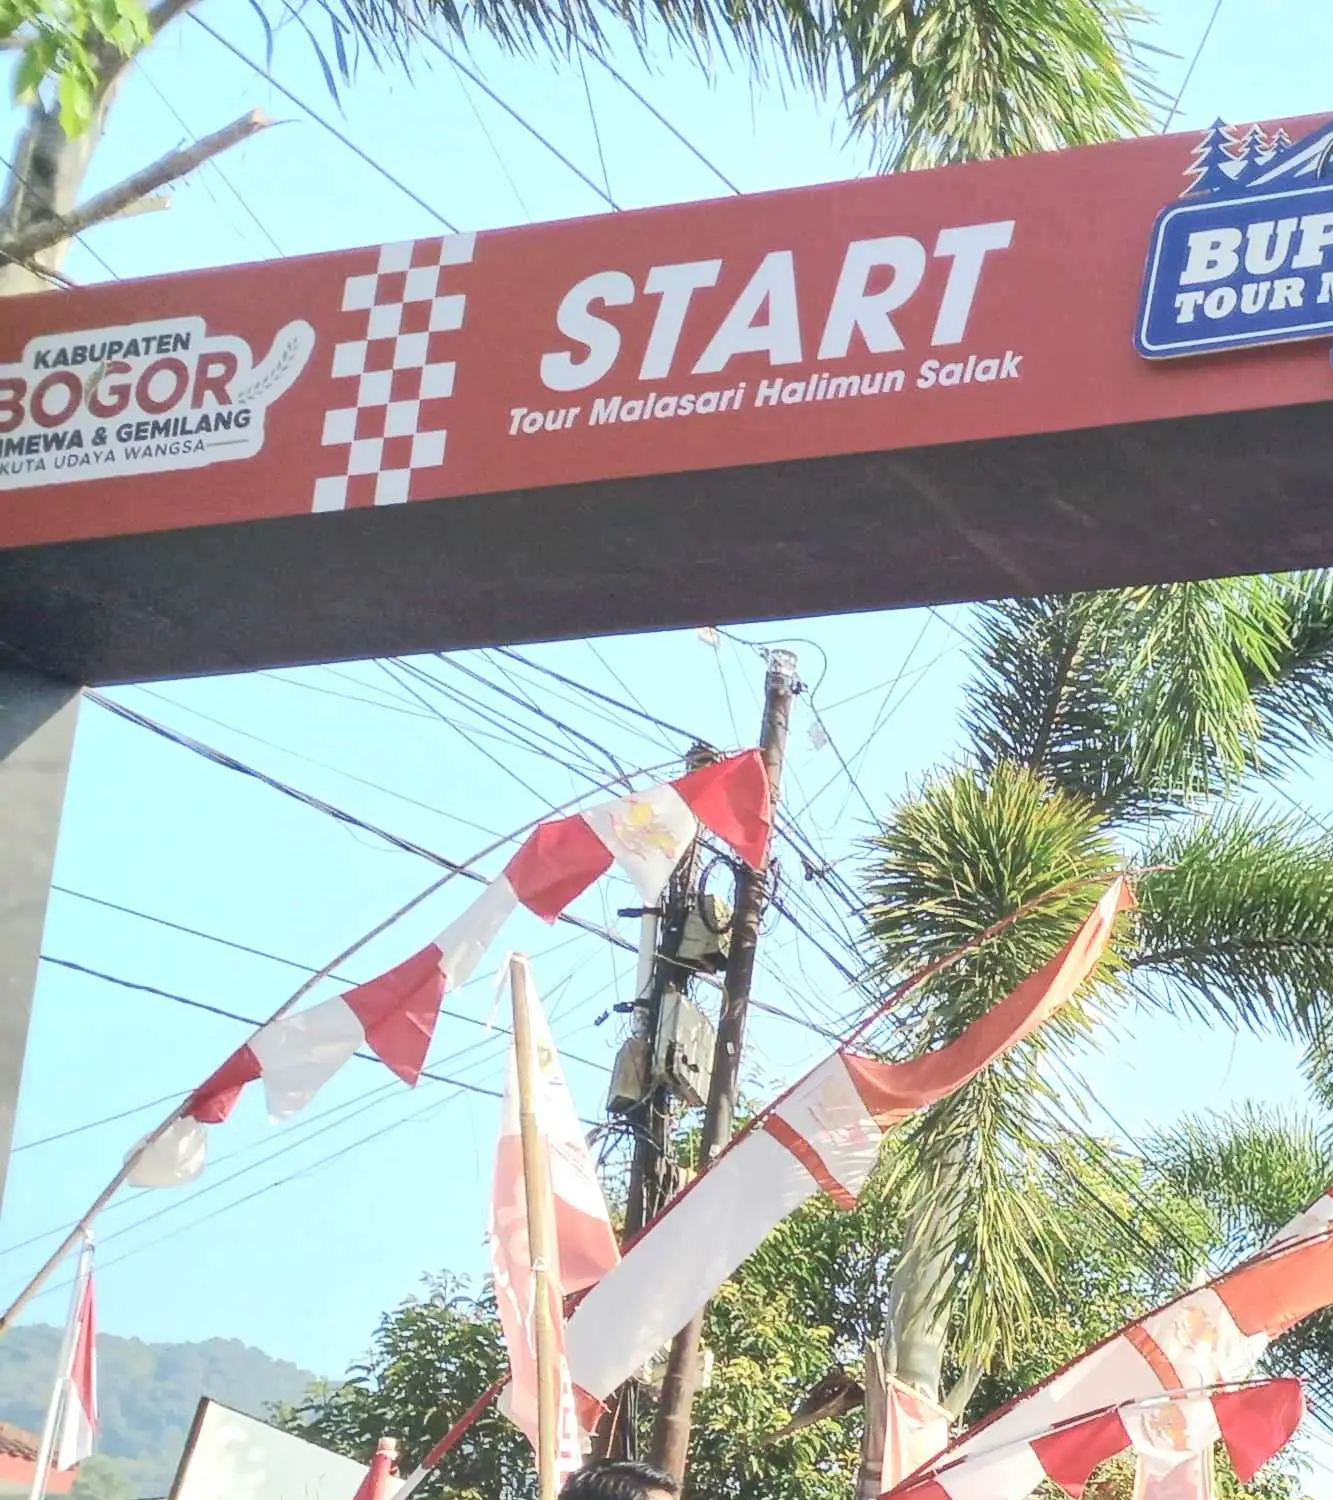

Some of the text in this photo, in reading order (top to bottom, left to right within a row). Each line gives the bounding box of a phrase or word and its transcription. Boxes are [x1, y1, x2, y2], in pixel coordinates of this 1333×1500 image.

[539, 220, 1016, 393] START
[1174, 277, 1304, 326] TOUR
[34, 332, 192, 370] KABUPATEN
[0, 351, 238, 434] BOGOR
[508, 350, 1024, 436] Tour Malasari Halimun Salak
[0, 409, 252, 458] IMEWA & GEMILANG
[54, 450, 116, 470] UDAYA
[124, 439, 206, 461] WANGSA
